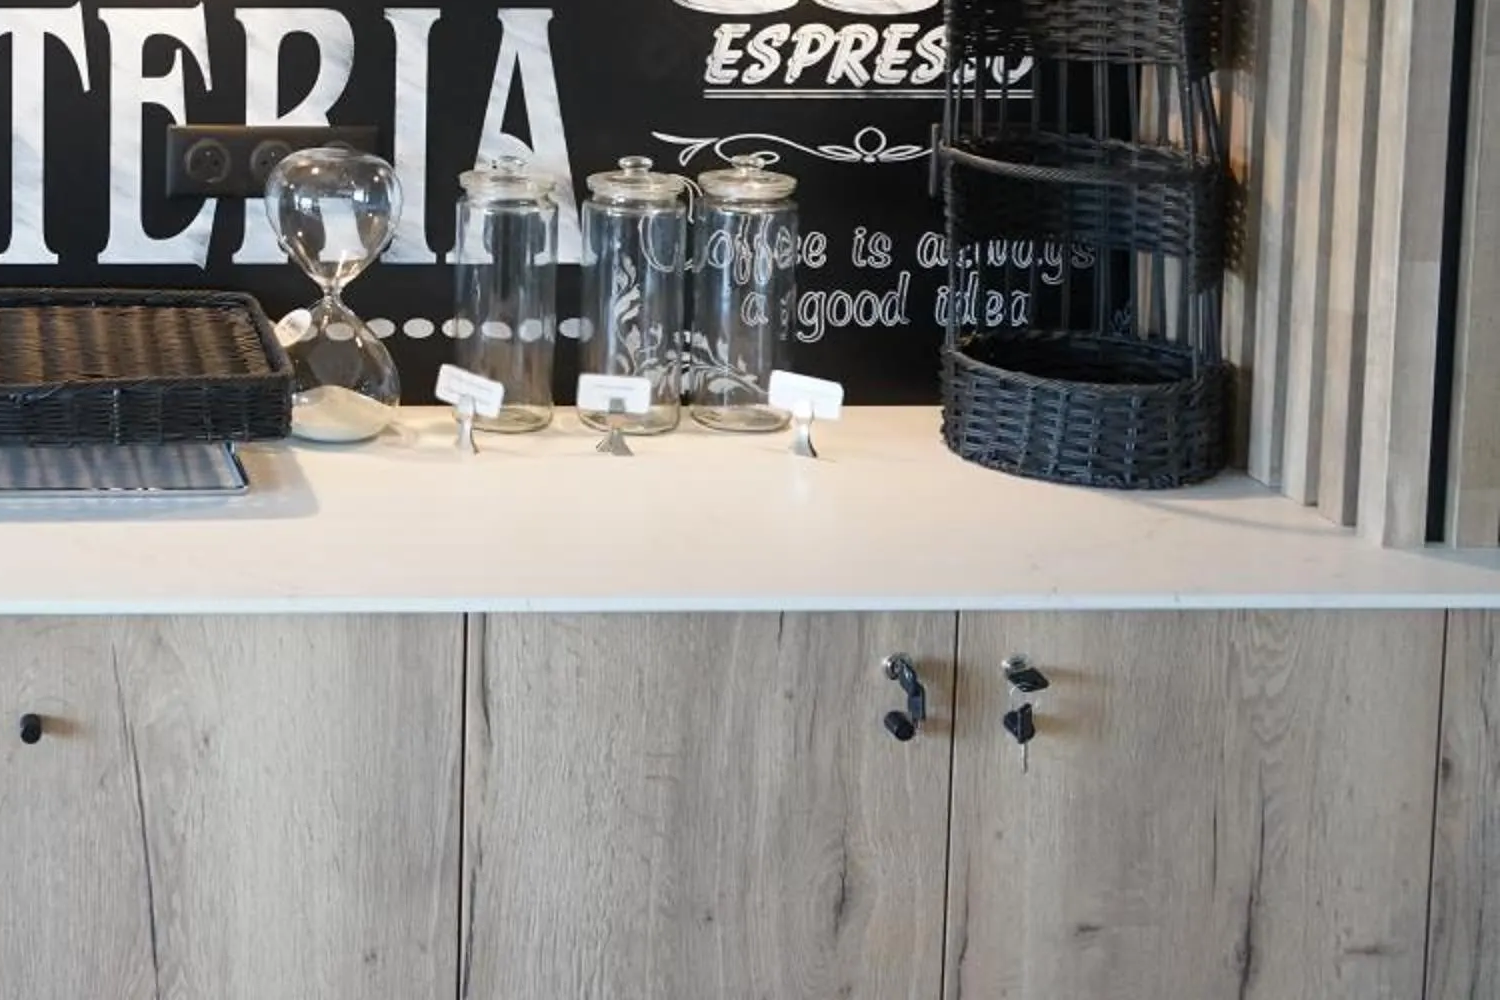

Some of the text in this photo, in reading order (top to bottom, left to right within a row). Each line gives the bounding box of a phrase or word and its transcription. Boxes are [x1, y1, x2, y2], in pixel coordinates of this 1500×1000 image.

[851, 227, 893, 269] is
[741, 292, 770, 327] a
[796, 271, 912, 343] good
